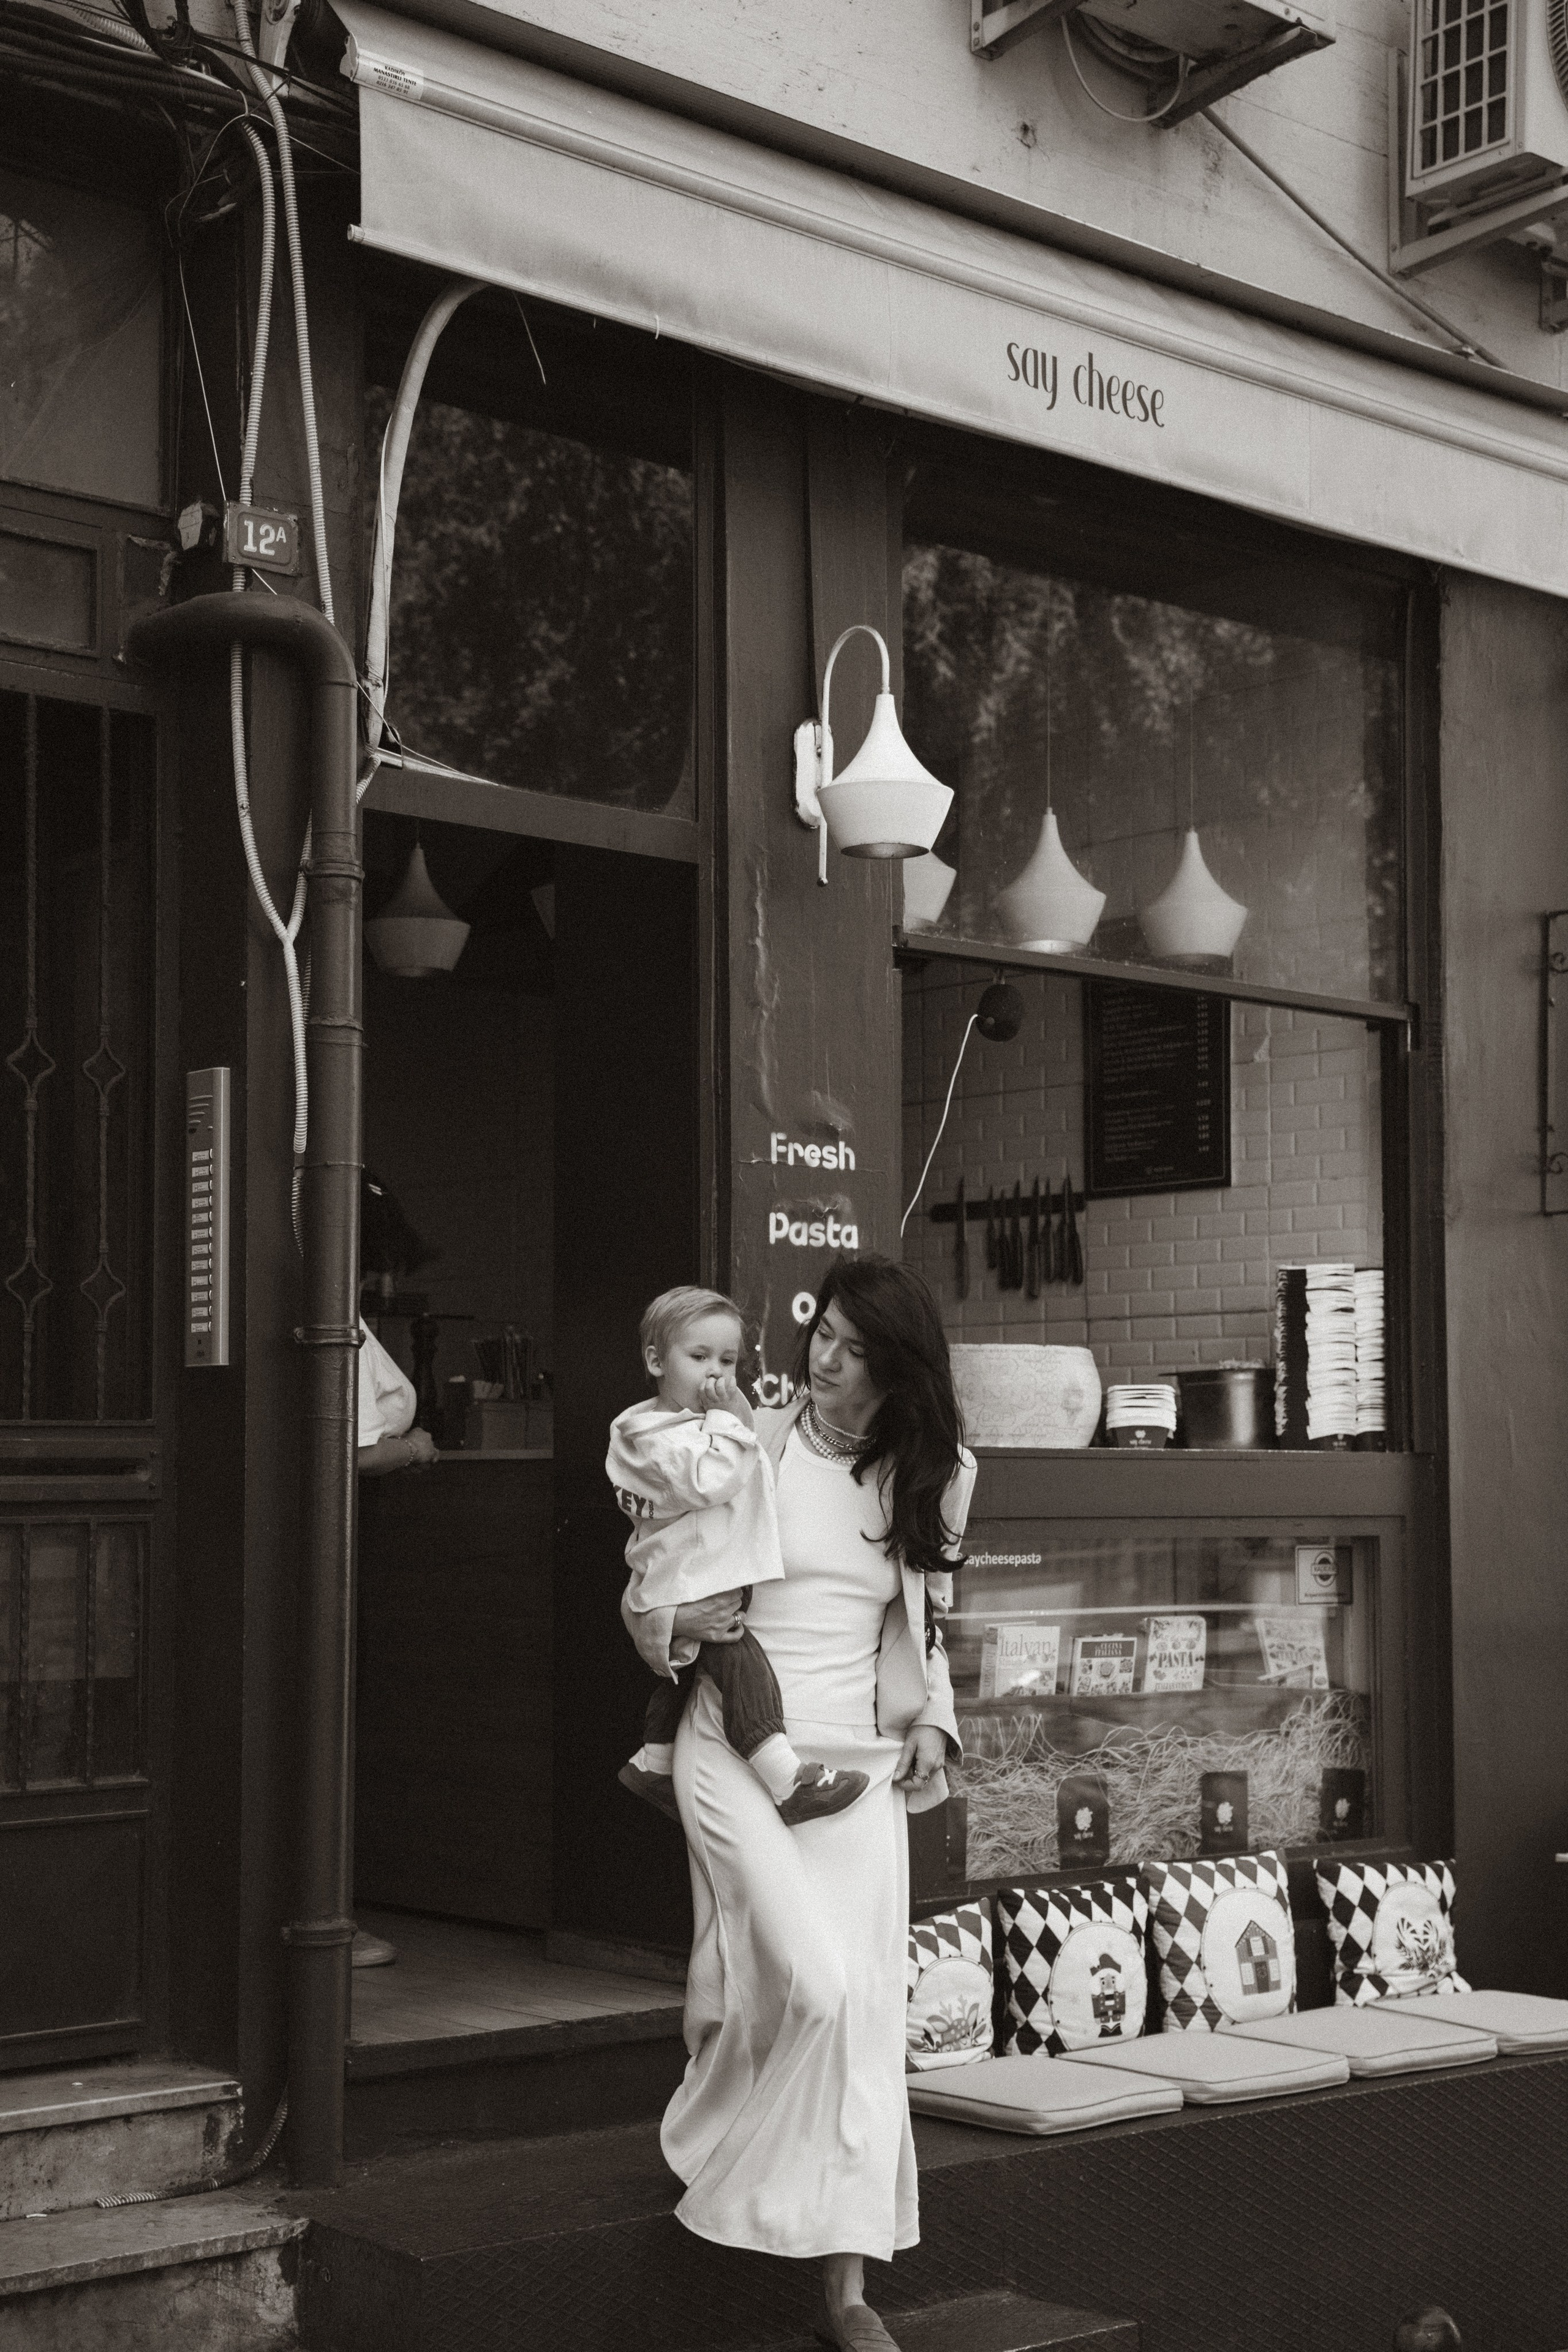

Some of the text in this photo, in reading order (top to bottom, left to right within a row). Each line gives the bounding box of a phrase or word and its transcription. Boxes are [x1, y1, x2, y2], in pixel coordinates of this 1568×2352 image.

[374, 67, 417, 86] MANASTIRLI TENTE
[385, 66, 405, 76] KADIKÖY
[1007, 342, 1165, 428] say cheese
[244, 520, 287, 556] 12A
[771, 1133, 855, 1170] Fresh
[769, 1212, 858, 1249] Pasta
[1158, 1651, 1194, 1668] PASTA
